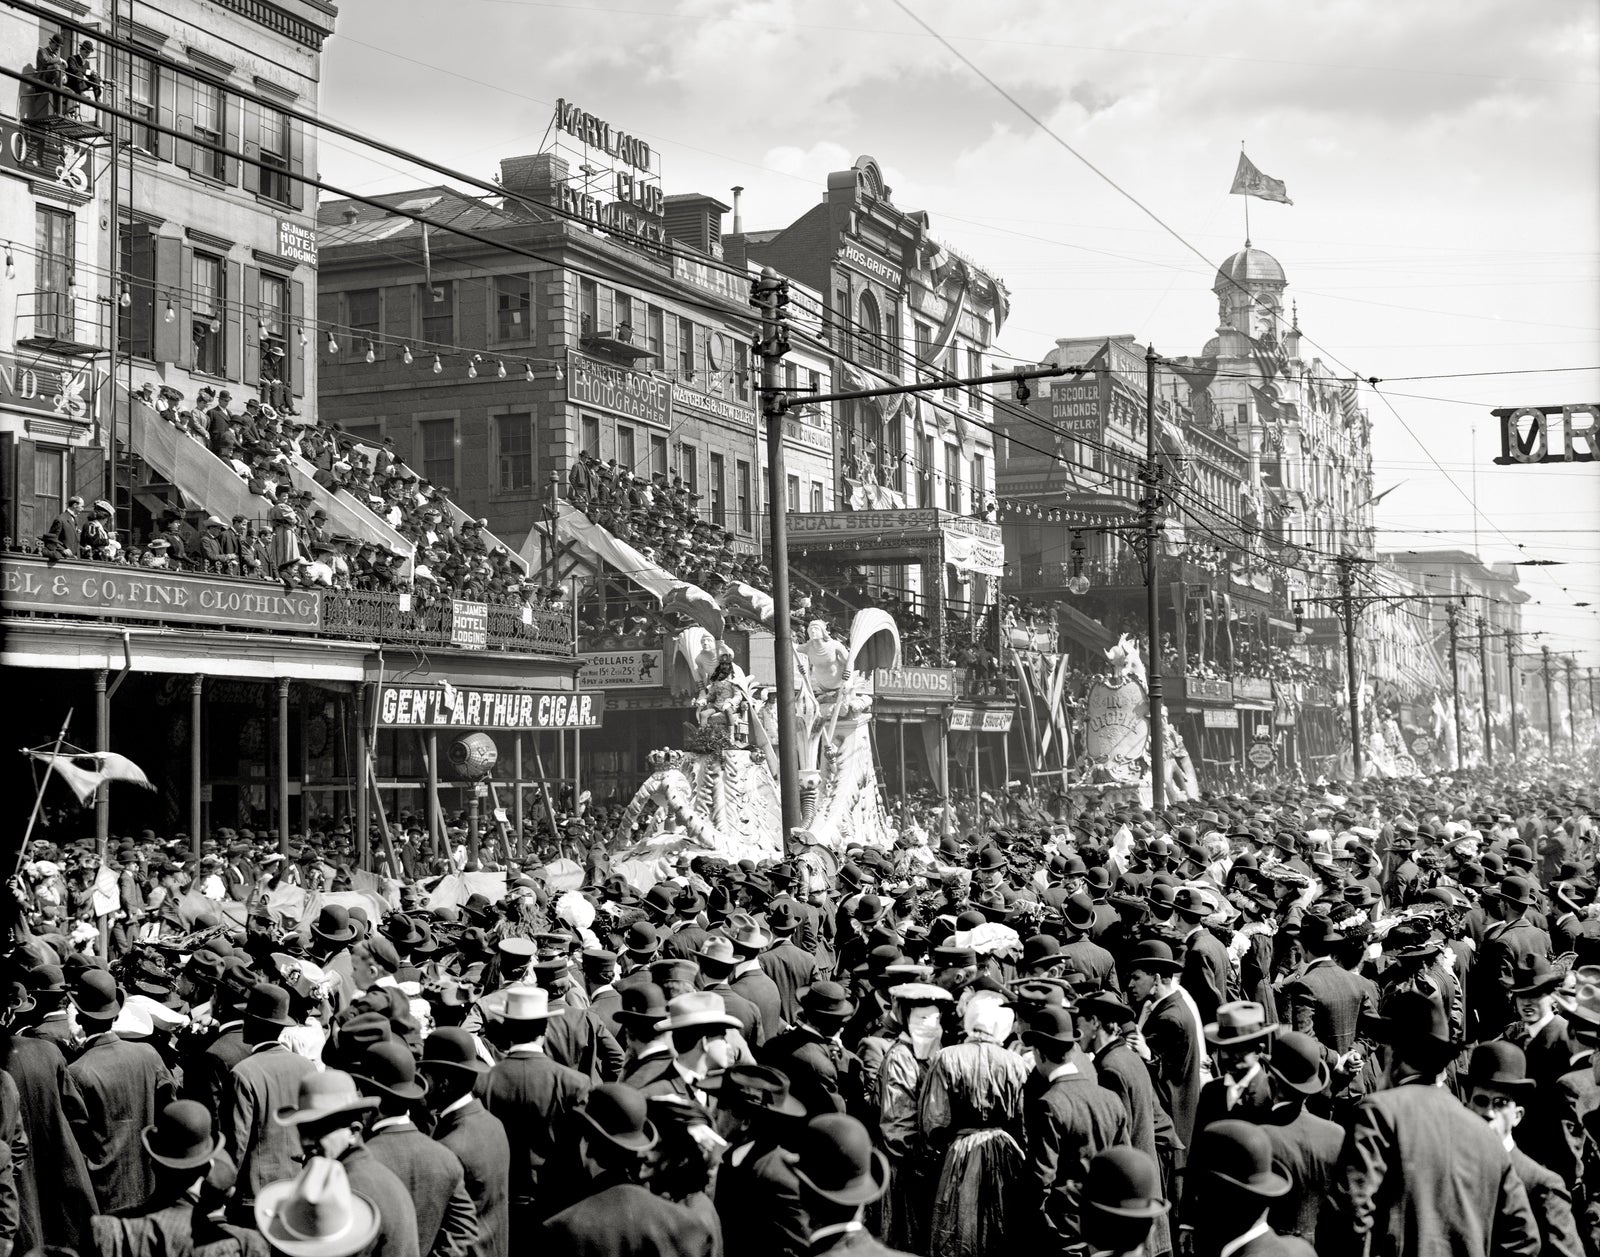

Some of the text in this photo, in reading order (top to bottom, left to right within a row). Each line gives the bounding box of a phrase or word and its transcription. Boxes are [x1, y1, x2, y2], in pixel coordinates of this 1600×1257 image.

[556, 98, 650, 174] MARYLAND
[617, 171, 665, 218] CLUB
[280, 231, 318, 253] HOTEL
[281, 242, 317, 265] LODGING
[846, 513, 894, 529] SHOE
[52, 574, 70, 596] &
[127, 582, 190, 607] FINE
[200, 590, 312, 617] CLOTHING
[454, 615, 486, 631] HOTEL
[452, 629, 486, 644] LODGING
[593, 656, 635, 666] COLLARS
[878, 668, 952, 690] DIAMONDS.
[382, 688, 448, 725] GEN'L
[450, 691, 533, 727] ARTHUR
